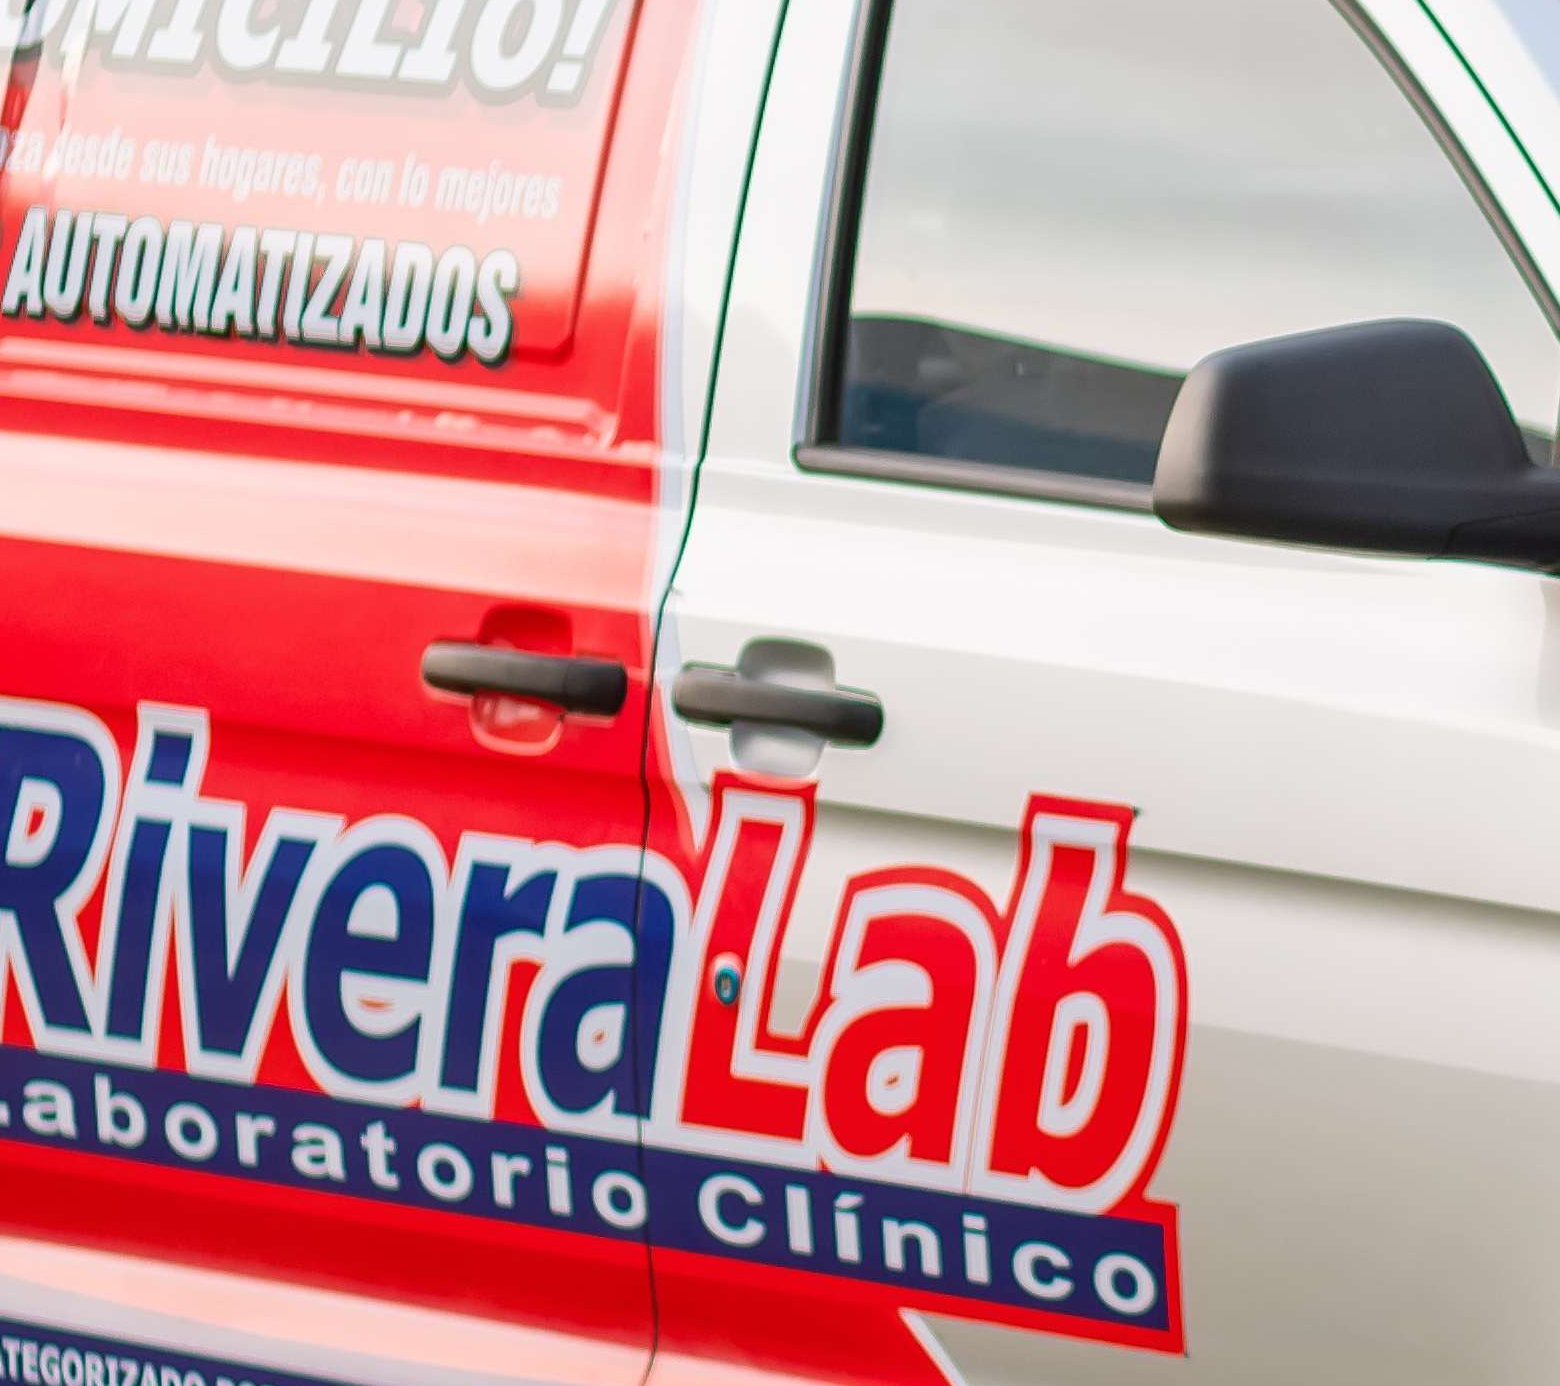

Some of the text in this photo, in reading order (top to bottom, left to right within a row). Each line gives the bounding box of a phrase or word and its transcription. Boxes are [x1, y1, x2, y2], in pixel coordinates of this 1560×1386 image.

[141, 138, 195, 186] sus
[336, 154, 394, 204] con
[397, 151, 431, 208] lo
[435, 158, 564, 225] mejores
[0, 205, 522, 368] AUTOMATIZADOS
[698, 1172, 1160, 1316] Clínico
